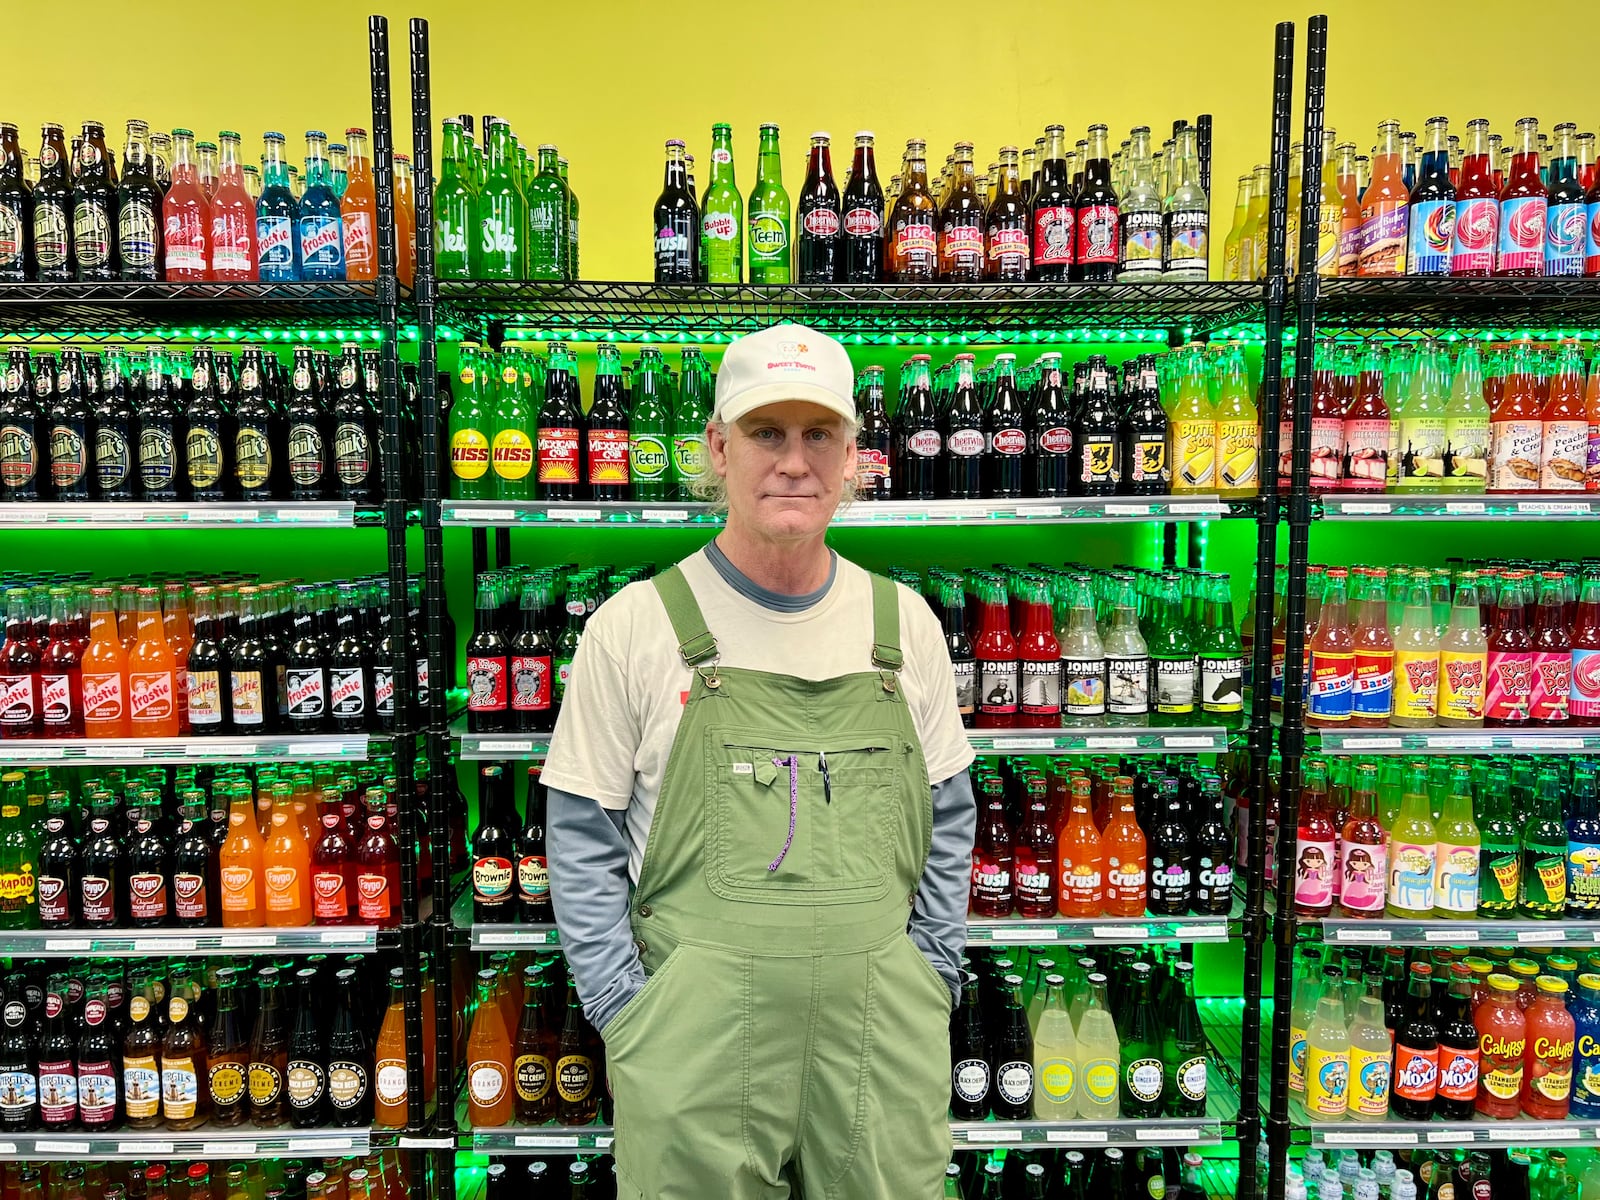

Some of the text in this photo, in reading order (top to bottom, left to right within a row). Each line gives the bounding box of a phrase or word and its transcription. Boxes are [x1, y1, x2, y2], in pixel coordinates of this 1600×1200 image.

[704, 216, 732, 231] Bubble
[1126, 213, 1162, 225] JONES
[1171, 213, 1208, 225] JONES
[482, 217, 518, 253] Ski
[908, 229, 929, 239] IBC
[956, 230, 976, 240] IBC
[1001, 233, 1021, 242] IBC
[302, 228, 338, 255] Frostie
[950, 241, 968, 249] CREAM
[1044, 244, 1071, 259] Cola
[1087, 243, 1114, 258] Cola
[909, 436, 941, 450] Cheerwin
[949, 435, 985, 446] Cheerwin
[1186, 436, 1213, 453] SODA
[1227, 437, 1255, 454] SODA
[1513, 433, 1541, 447] Peach
[452, 447, 489, 461] KISS
[494, 447, 531, 461] KISS
[1081, 445, 1091, 482] Sprecher
[1133, 444, 1143, 481] Sprecher
[478, 658, 502, 673] IRON
[523, 658, 546, 672] IRON
[982, 661, 1018, 672] JONES
[1022, 661, 1060, 672] JONES
[1067, 661, 1105, 672] JONES
[1109, 660, 1147, 671] JONES
[1157, 660, 1194, 671] JONES
[1202, 659, 1242, 671] JONES
[1316, 666, 1337, 676] NEW!
[1357, 664, 1379, 674] NEW!
[1405, 659, 1438, 678] Ring
[1445, 659, 1482, 679] Ring
[1499, 659, 1532, 678] Ring
[1539, 659, 1571, 678] Ring
[1319, 673, 1352, 692] Bazoo
[0, 687, 29, 710] rostie
[83, 685, 119, 711] Frostie
[132, 683, 169, 711] Frostie
[288, 680, 321, 707] Frostie
[469, 692, 497, 707] Cola
[514, 691, 541, 707] Cola
[223, 871, 247, 884] Faygo
[268, 871, 291, 884] Faygo
[475, 869, 511, 883] Brownie
[520, 869, 549, 882] Brown
[973, 868, 1010, 887] Crush
[1015, 868, 1050, 888] Crush
[1062, 871, 1101, 889] Crush
[1108, 870, 1146, 887] Crush
[1152, 869, 1190, 887] Crush
[39, 880, 59, 894] Faygo
[83, 880, 104, 894] Faygo
[134, 877, 158, 891] Faygo
[176, 877, 198, 892] Faygo
[316, 878, 338, 891] Faygo
[360, 878, 381, 892] Faygo
[1291, 1033, 1303, 1041] LOS
[1534, 1037, 1575, 1061] Calyps
[11, 1063, 28, 1071] BEER
[49, 1062, 70, 1070] CHERRY
[88, 1063, 109, 1071] CHERRY
[1318, 1056, 1332, 1064] LOS
[1359, 1056, 1373, 1064] LOS
[209, 1063, 246, 1079] BOYLAN
[518, 1073, 546, 1082] DIET CREME
[561, 1073, 588, 1082] DIET CREME
[1398, 1065, 1438, 1089] Moxi
[1440, 1065, 1478, 1089] Moxi
[214, 1080, 240, 1088] CREME
[474, 1078, 501, 1087] ORANGE
[972, 1076, 985, 1084] CHERRY
[1489, 1081, 1519, 1089] LEMONADE
